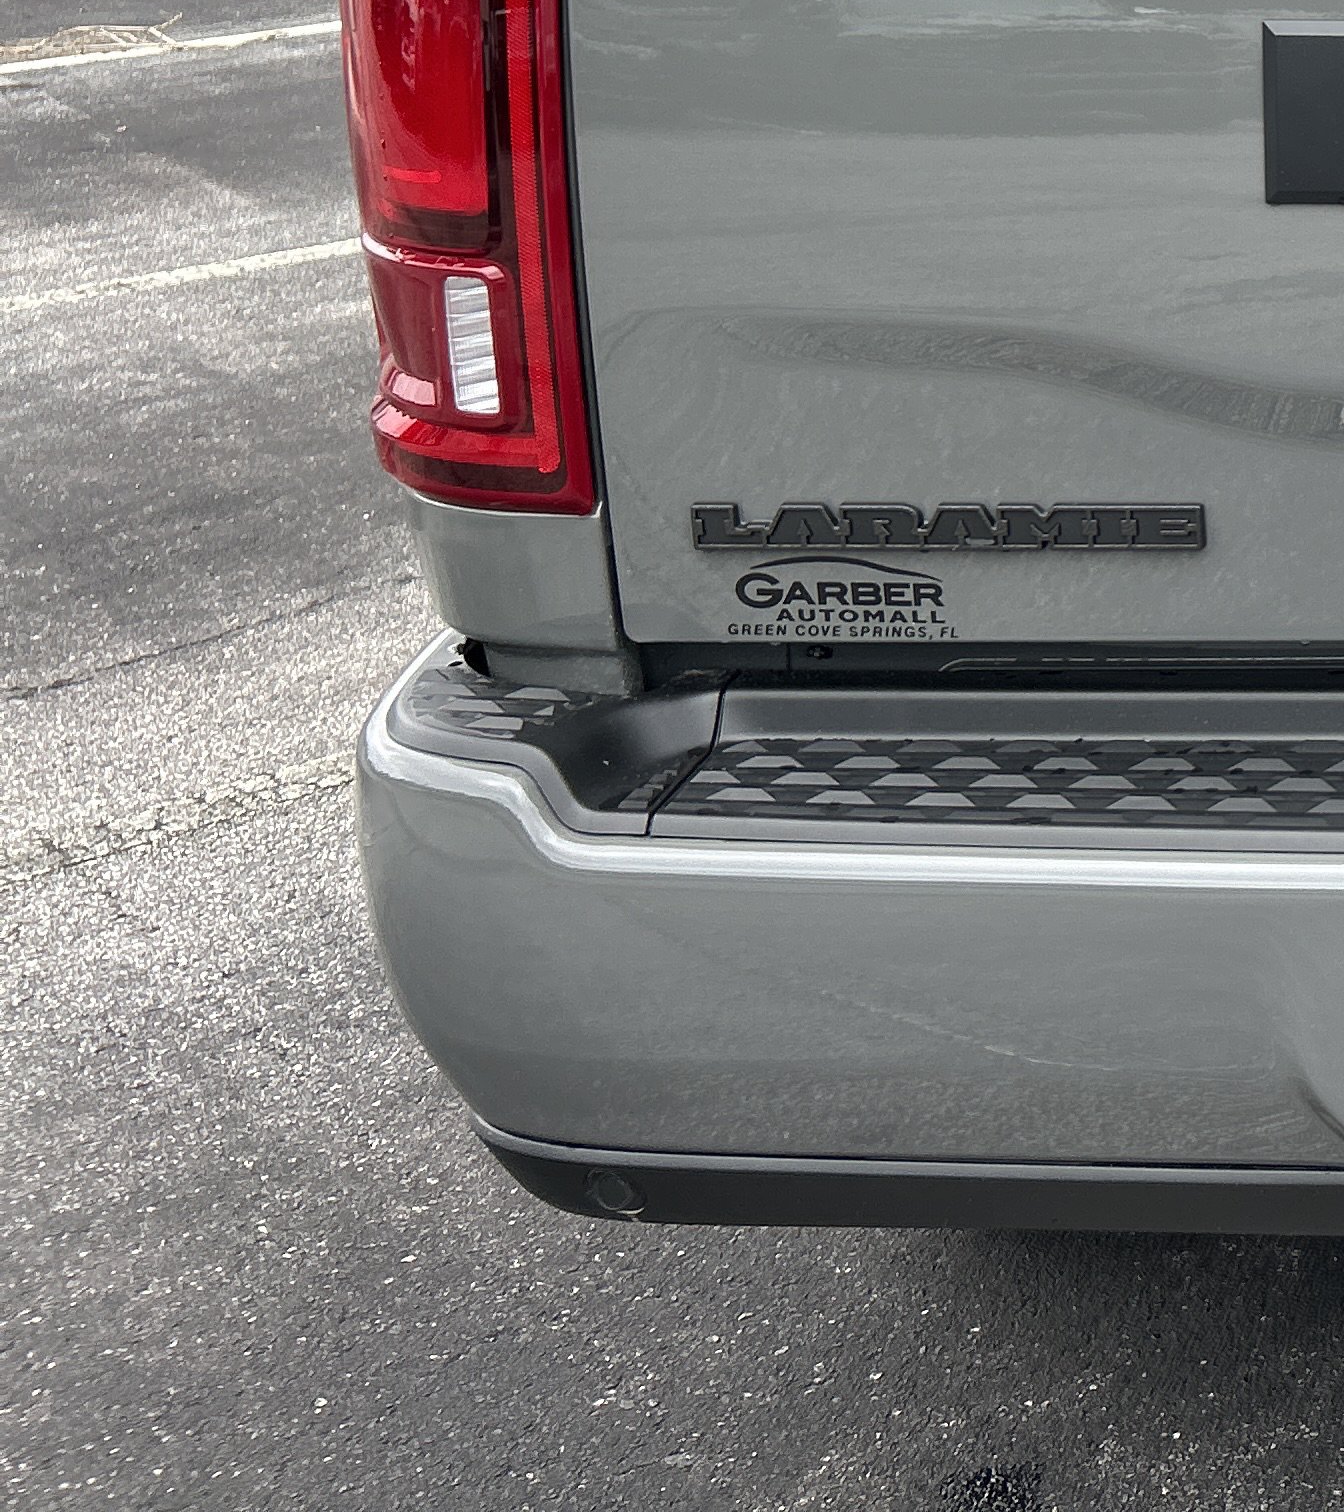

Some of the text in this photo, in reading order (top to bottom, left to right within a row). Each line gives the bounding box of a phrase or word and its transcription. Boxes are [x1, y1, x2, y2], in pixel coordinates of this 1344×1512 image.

[691, 502, 1206, 550] LARAMIE
[735, 572, 945, 609] GARBER
[776, 608, 946, 624] AUTOMALL
[728, 623, 959, 640] GREEN COVE SPRINGS, FL
